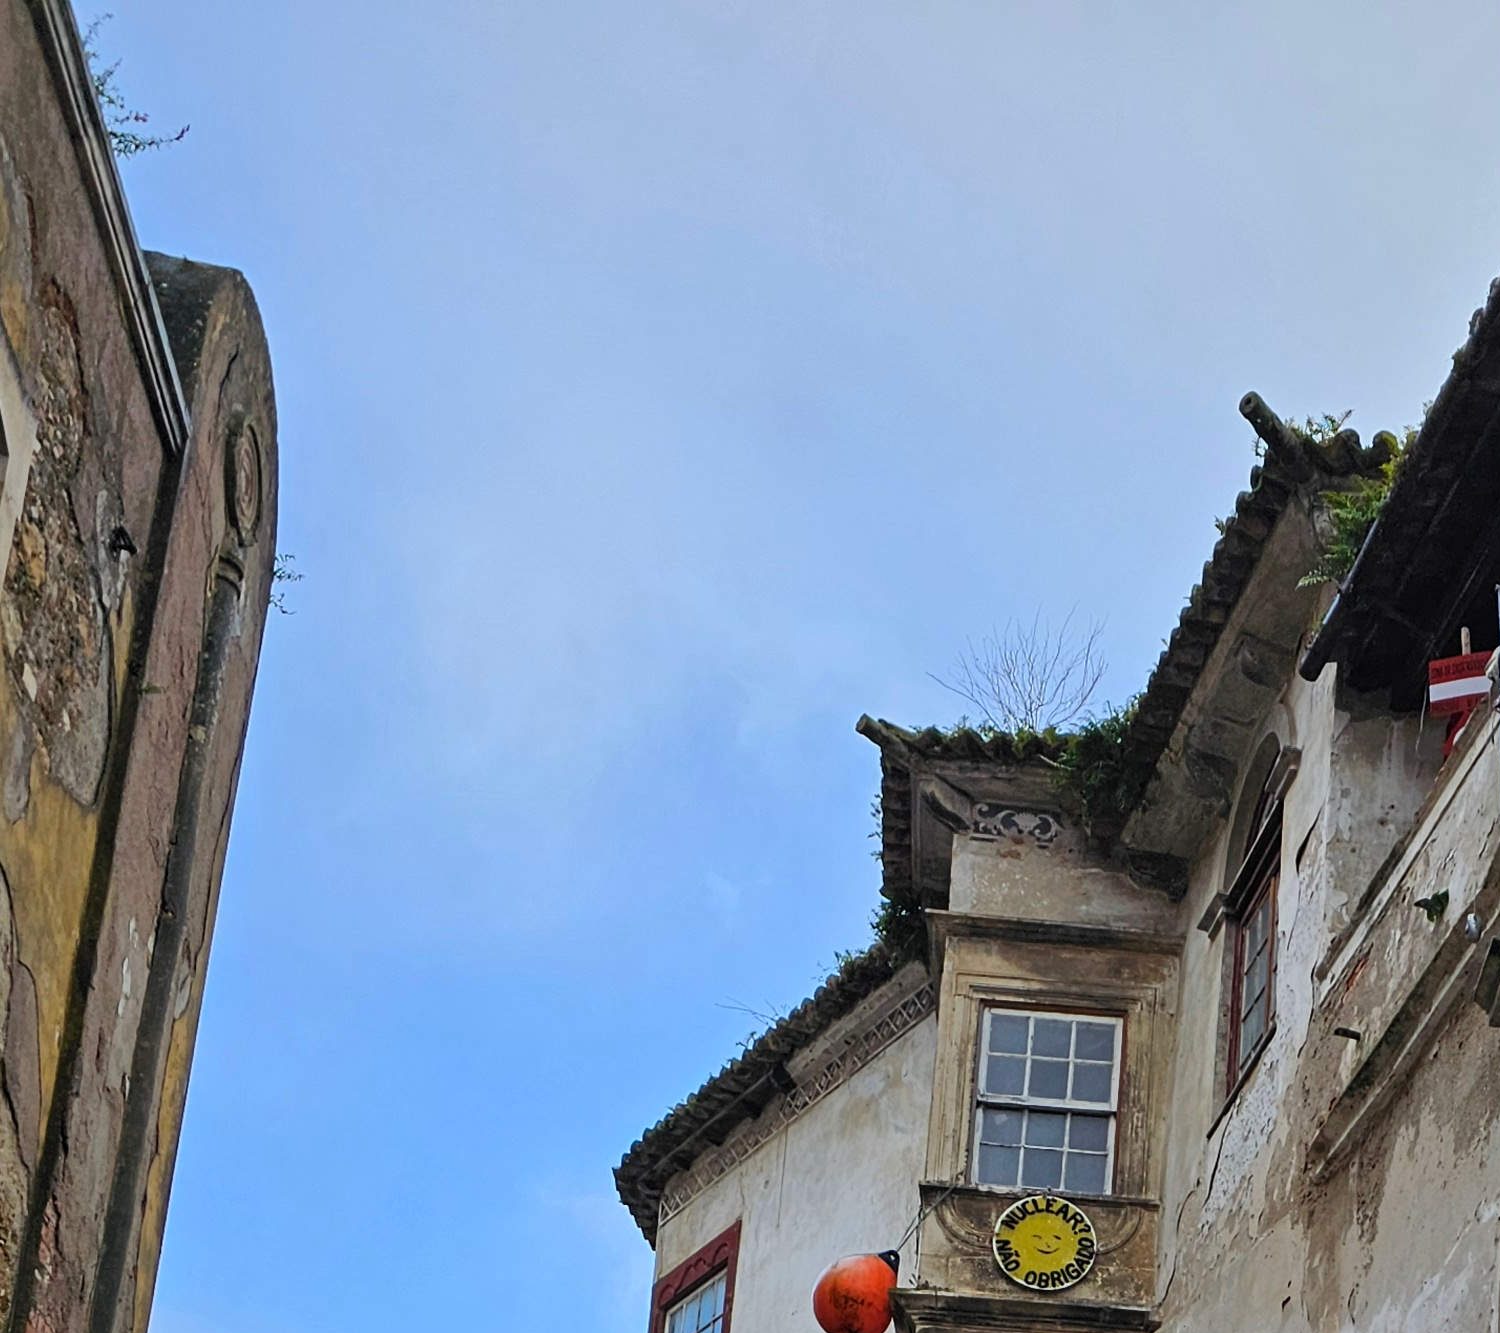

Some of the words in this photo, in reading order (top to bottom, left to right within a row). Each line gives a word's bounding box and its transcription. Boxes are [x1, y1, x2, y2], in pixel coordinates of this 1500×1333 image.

[1001, 1199, 1092, 1235] NUCLEAR?
[996, 1239, 1021, 1272] NÃO
[1024, 1237, 1095, 1288] OBRIGADO
